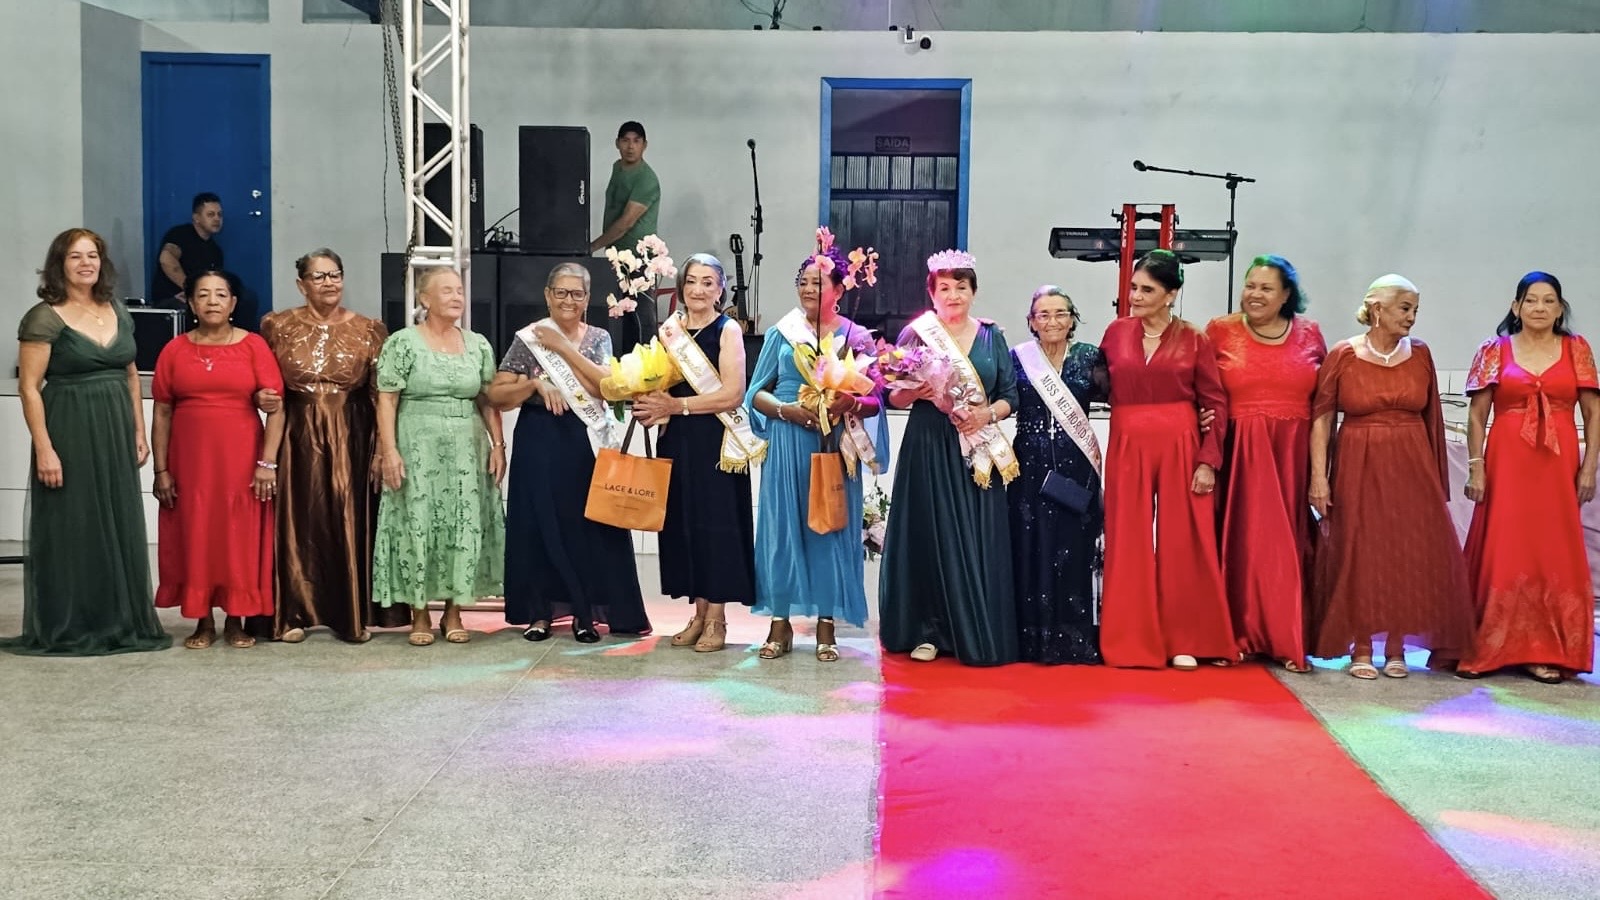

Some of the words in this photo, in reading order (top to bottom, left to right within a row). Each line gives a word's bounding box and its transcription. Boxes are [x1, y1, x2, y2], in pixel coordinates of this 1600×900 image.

[545, 351, 579, 392] ELEGANCE
[1041, 374, 1060, 397] MISS
[1055, 396, 1082, 429] MELHOR
[604, 483, 626, 493] LACE
[627, 485, 633, 494] &
[634, 488, 656, 498] LORE
